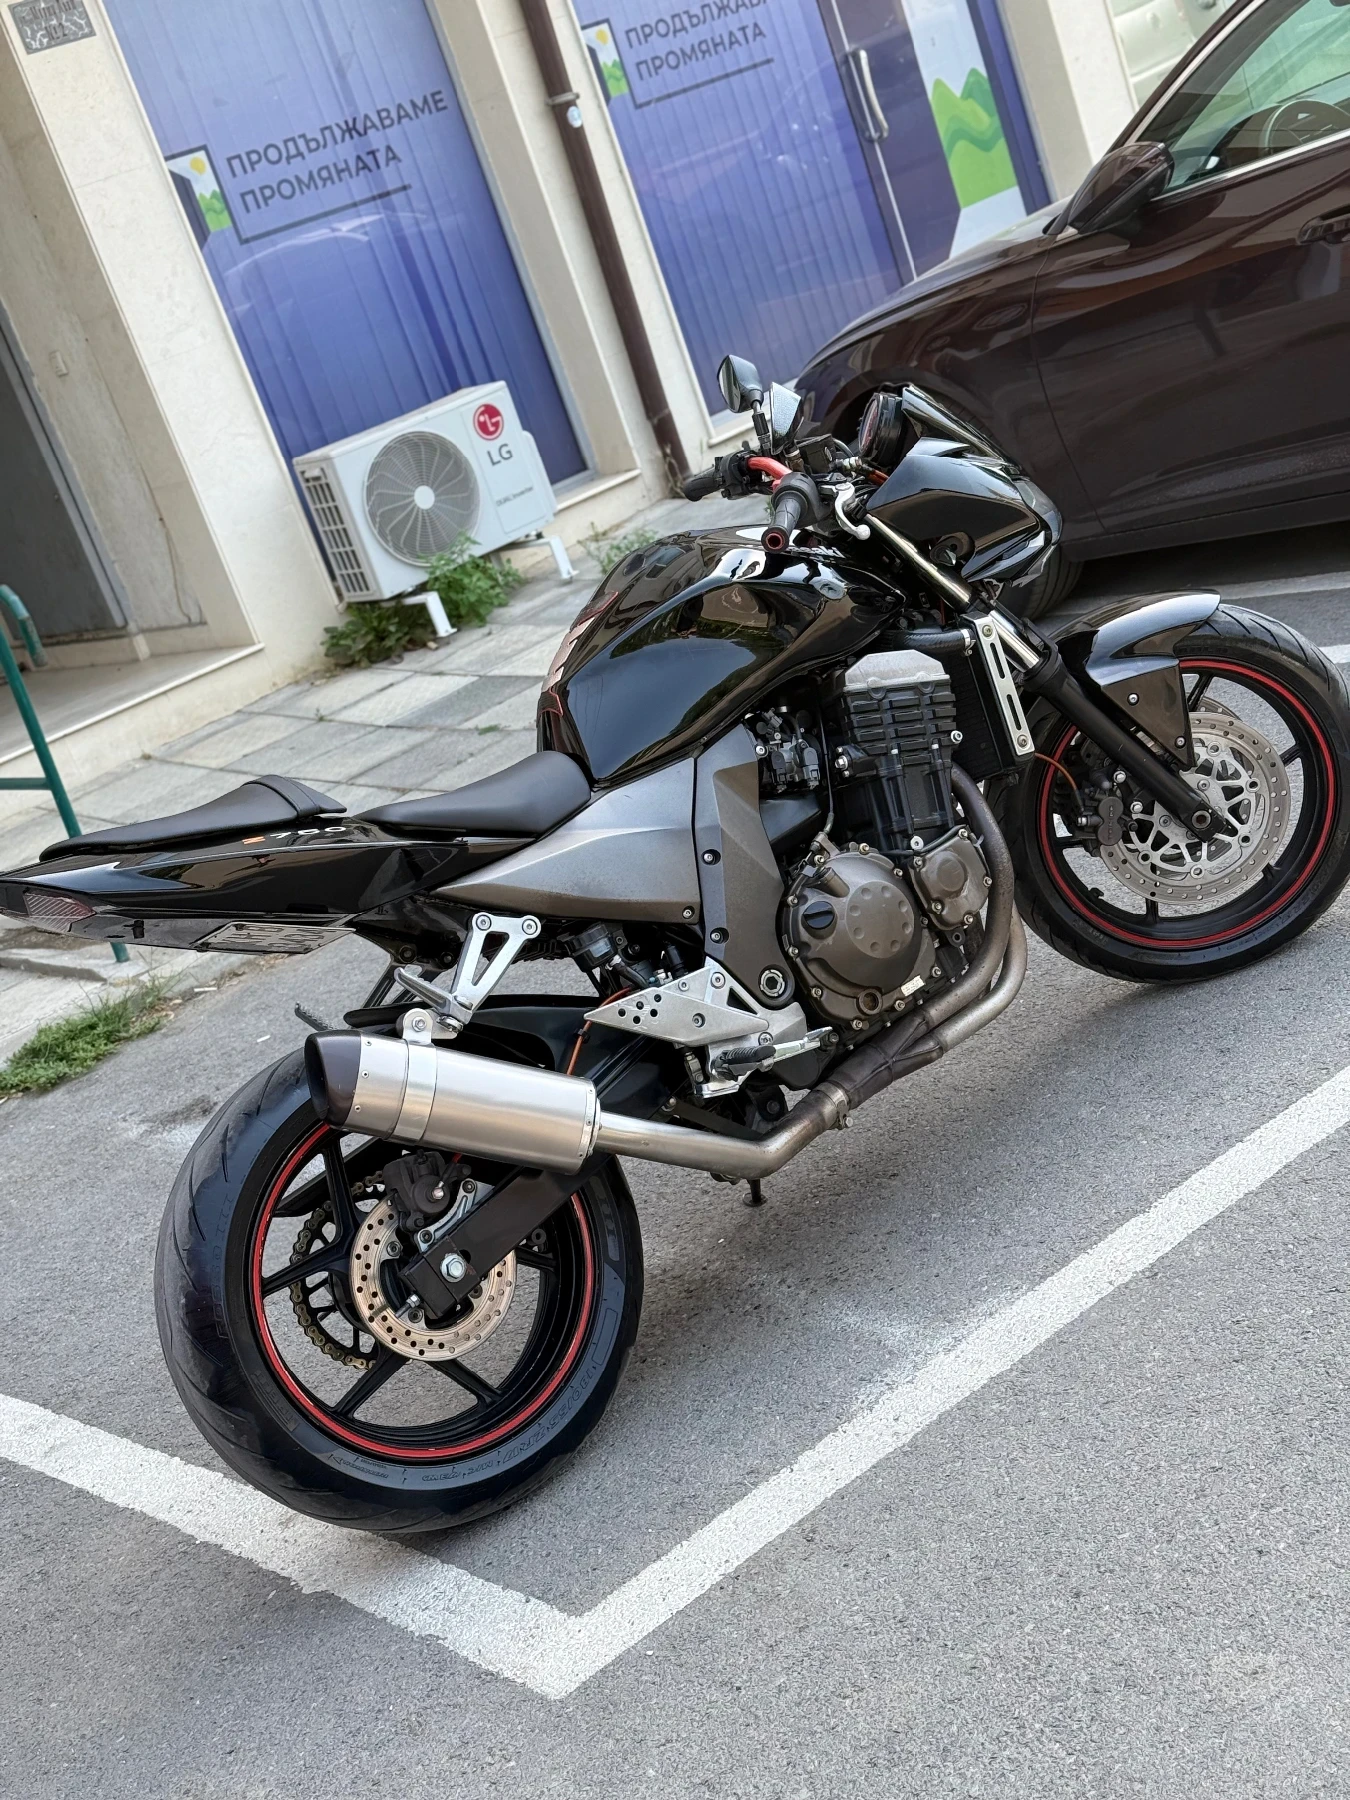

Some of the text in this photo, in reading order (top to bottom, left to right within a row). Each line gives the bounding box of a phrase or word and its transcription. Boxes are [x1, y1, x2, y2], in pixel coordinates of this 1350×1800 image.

[635, 22, 767, 81] ПРОМЯНАТА
[226, 90, 449, 178] ПРОДЪЛЖАВАМЕ
[239, 144, 402, 214] ПРОМЯНАТА
[487, 443, 513, 466] LG
